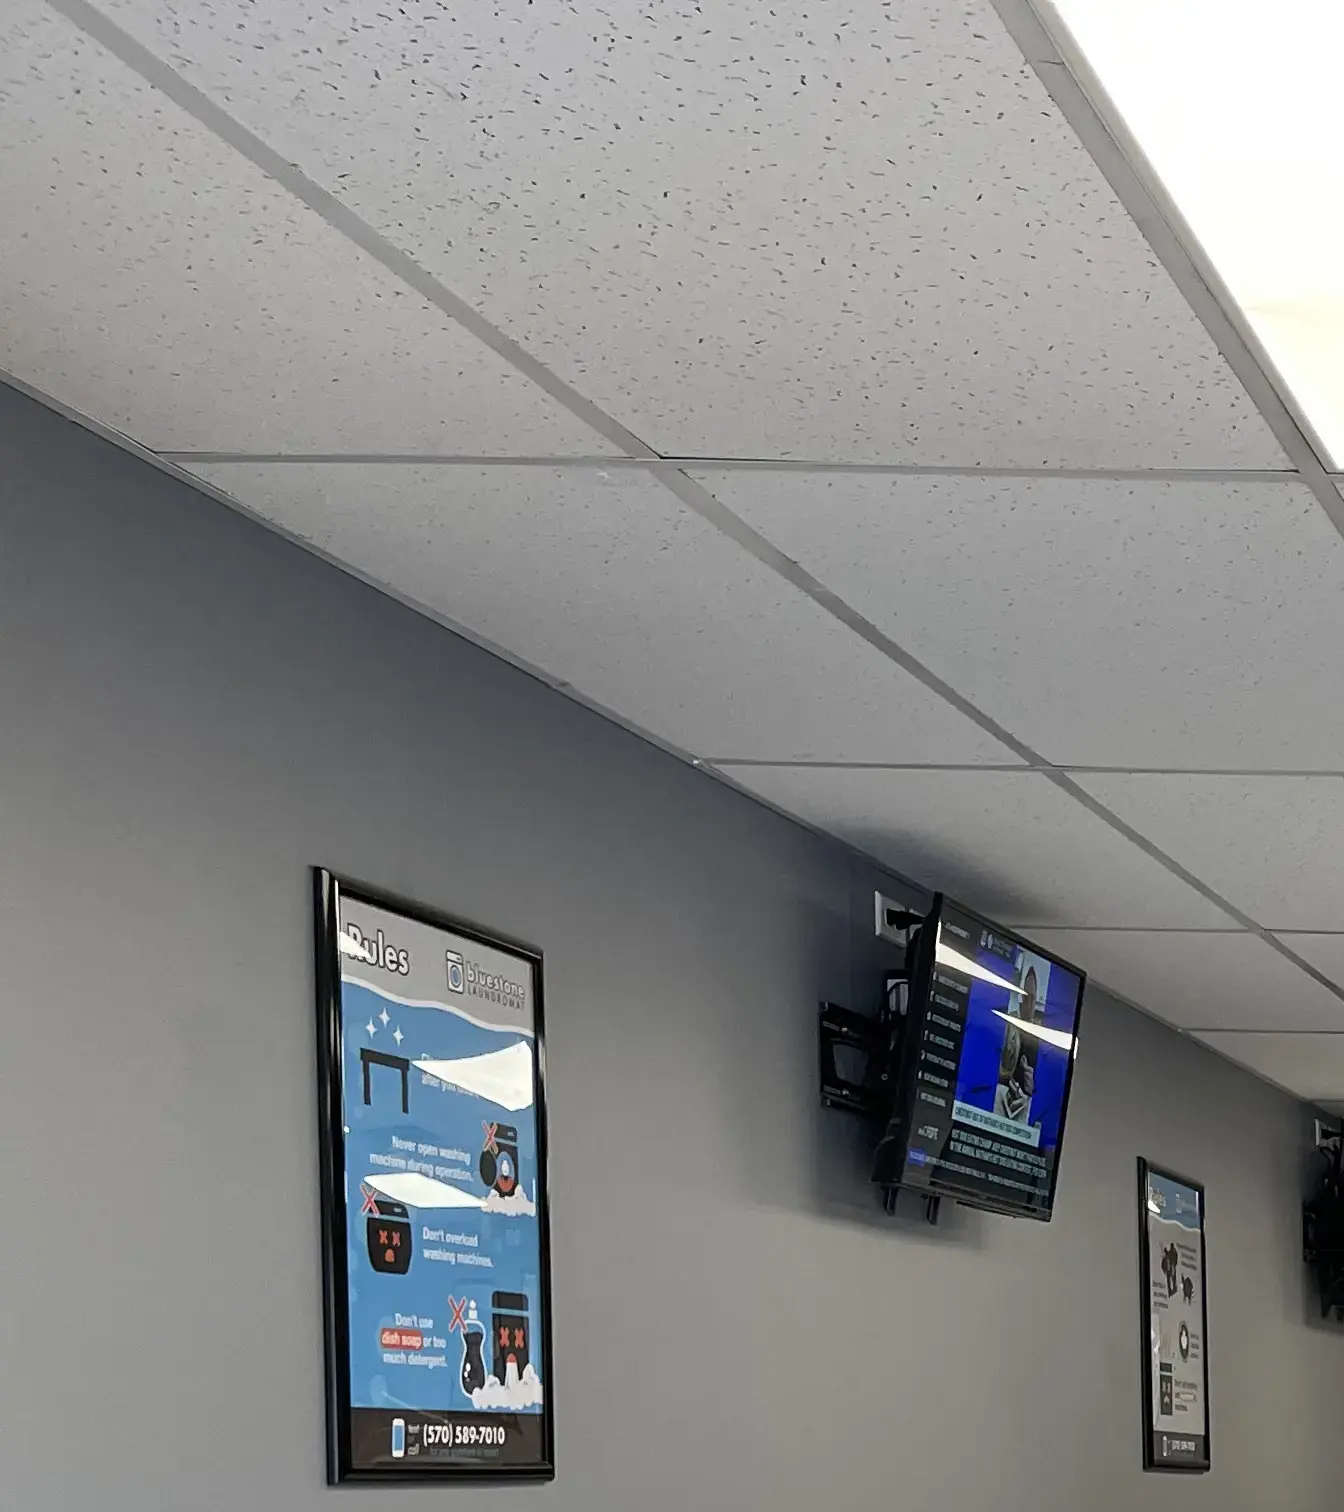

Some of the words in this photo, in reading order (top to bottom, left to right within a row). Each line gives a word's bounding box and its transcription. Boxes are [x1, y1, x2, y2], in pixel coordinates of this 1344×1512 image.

[347, 922, 410, 976] Rules
[466, 960, 525, 999] bluestone
[467, 985, 526, 1012] LAUNDROMAT
[391, 1135, 417, 1152] Never
[417, 1142, 438, 1158] open
[438, 1146, 471, 1167] washing
[369, 1153, 407, 1170] machine
[407, 1157, 434, 1177] during
[423, 1226, 445, 1242] Don't
[445, 1232, 479, 1248] overload
[422, 1248, 456, 1265] washing
[395, 1312, 419, 1328] Don't
[419, 1318, 434, 1329] use
[381, 1330, 401, 1346] dish
[401, 1333, 422, 1349] soap
[423, 1337, 433, 1348] or
[433, 1336, 447, 1349] too
[383, 1351, 406, 1364] much
[423, 1423, 453, 1448] (570)
[455, 1426, 506, 1446] 589-7010
